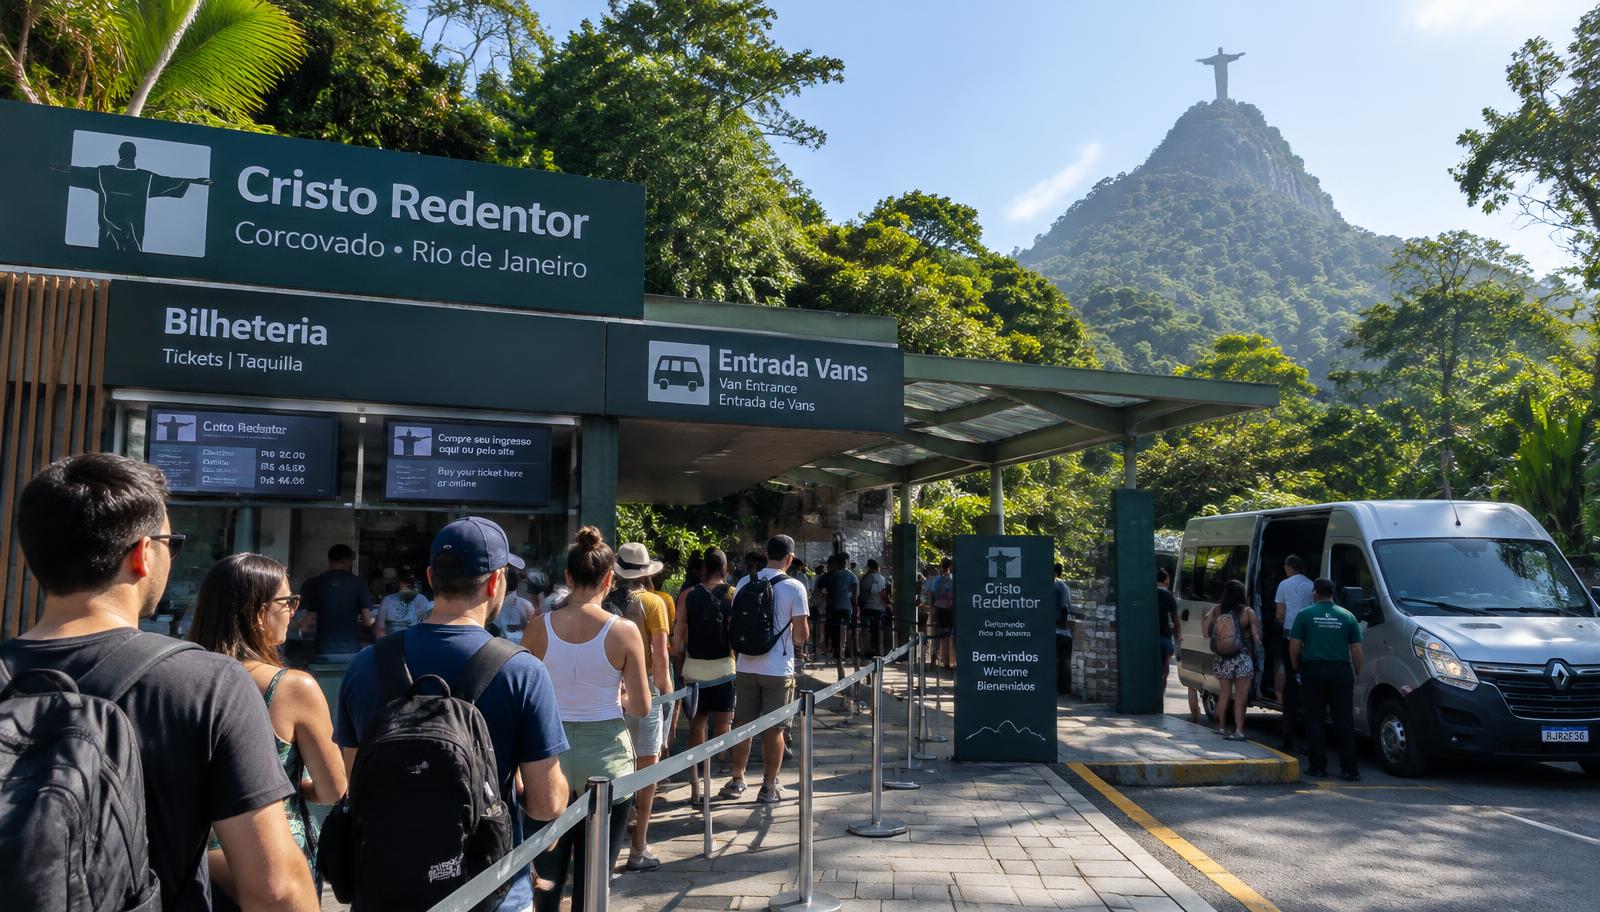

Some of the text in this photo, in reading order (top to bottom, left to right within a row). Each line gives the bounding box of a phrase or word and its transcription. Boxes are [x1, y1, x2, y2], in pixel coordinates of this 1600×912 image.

[237, 166, 590, 240] Cristo Redentor
[235, 220, 588, 279] Corcovado Rio de Janeiro
[164, 307, 329, 346] Bilheteria
[162, 348, 304, 373] Tickets Taquilla
[718, 349, 869, 383] Entrada Vans
[719, 377, 798, 394] Van Entrance
[719, 394, 816, 411] Entrada de Vans
[985, 582, 1021, 594] Cristo
[972, 594, 1041, 609] Redentor
[972, 651, 1039, 663] Bem-vindos
[983, 666, 1029, 677] Welcome
